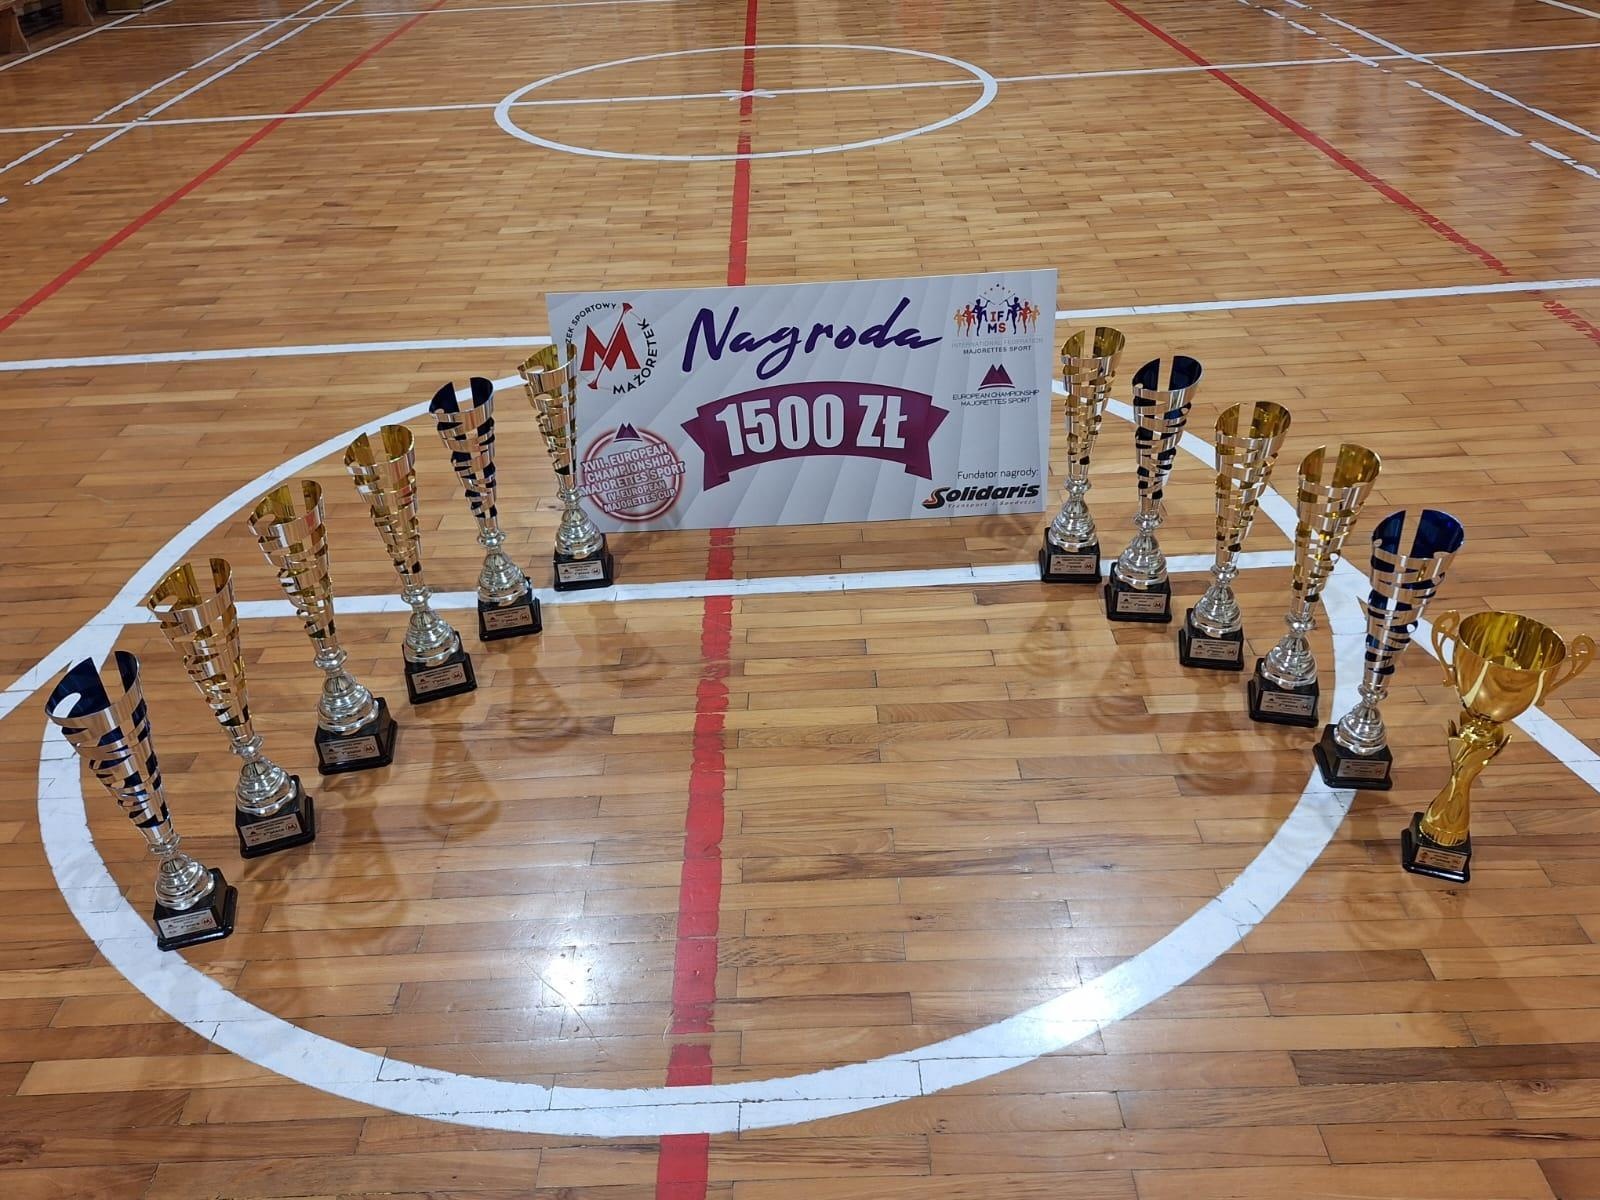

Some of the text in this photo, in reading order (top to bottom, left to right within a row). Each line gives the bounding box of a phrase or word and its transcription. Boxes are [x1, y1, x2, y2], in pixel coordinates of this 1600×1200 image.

[571, 302, 617, 327] SPORTOWY
[681, 296, 943, 380] Nagroda
[963, 346, 1007, 355] MAJORETTES
[612, 317, 658, 395] MAŻORETEK
[952, 389, 1040, 401] EUROPEAN CHAMPIONSHIP
[961, 396, 1032, 407] MAJORETTES SPORT
[715, 393, 908, 457] 1500 ZŁ
[608, 442, 668, 466] EUROPEAN
[580, 462, 686, 496] MAJORETTES SPORT
[587, 454, 671, 483] CHAMPIONSHIP
[957, 467, 1039, 480] Fundator nagrody:
[604, 488, 677, 513] MAJORETTES CUP
[620, 480, 667, 499] EUROPEAN
[922, 483, 1040, 509] Solidaris
